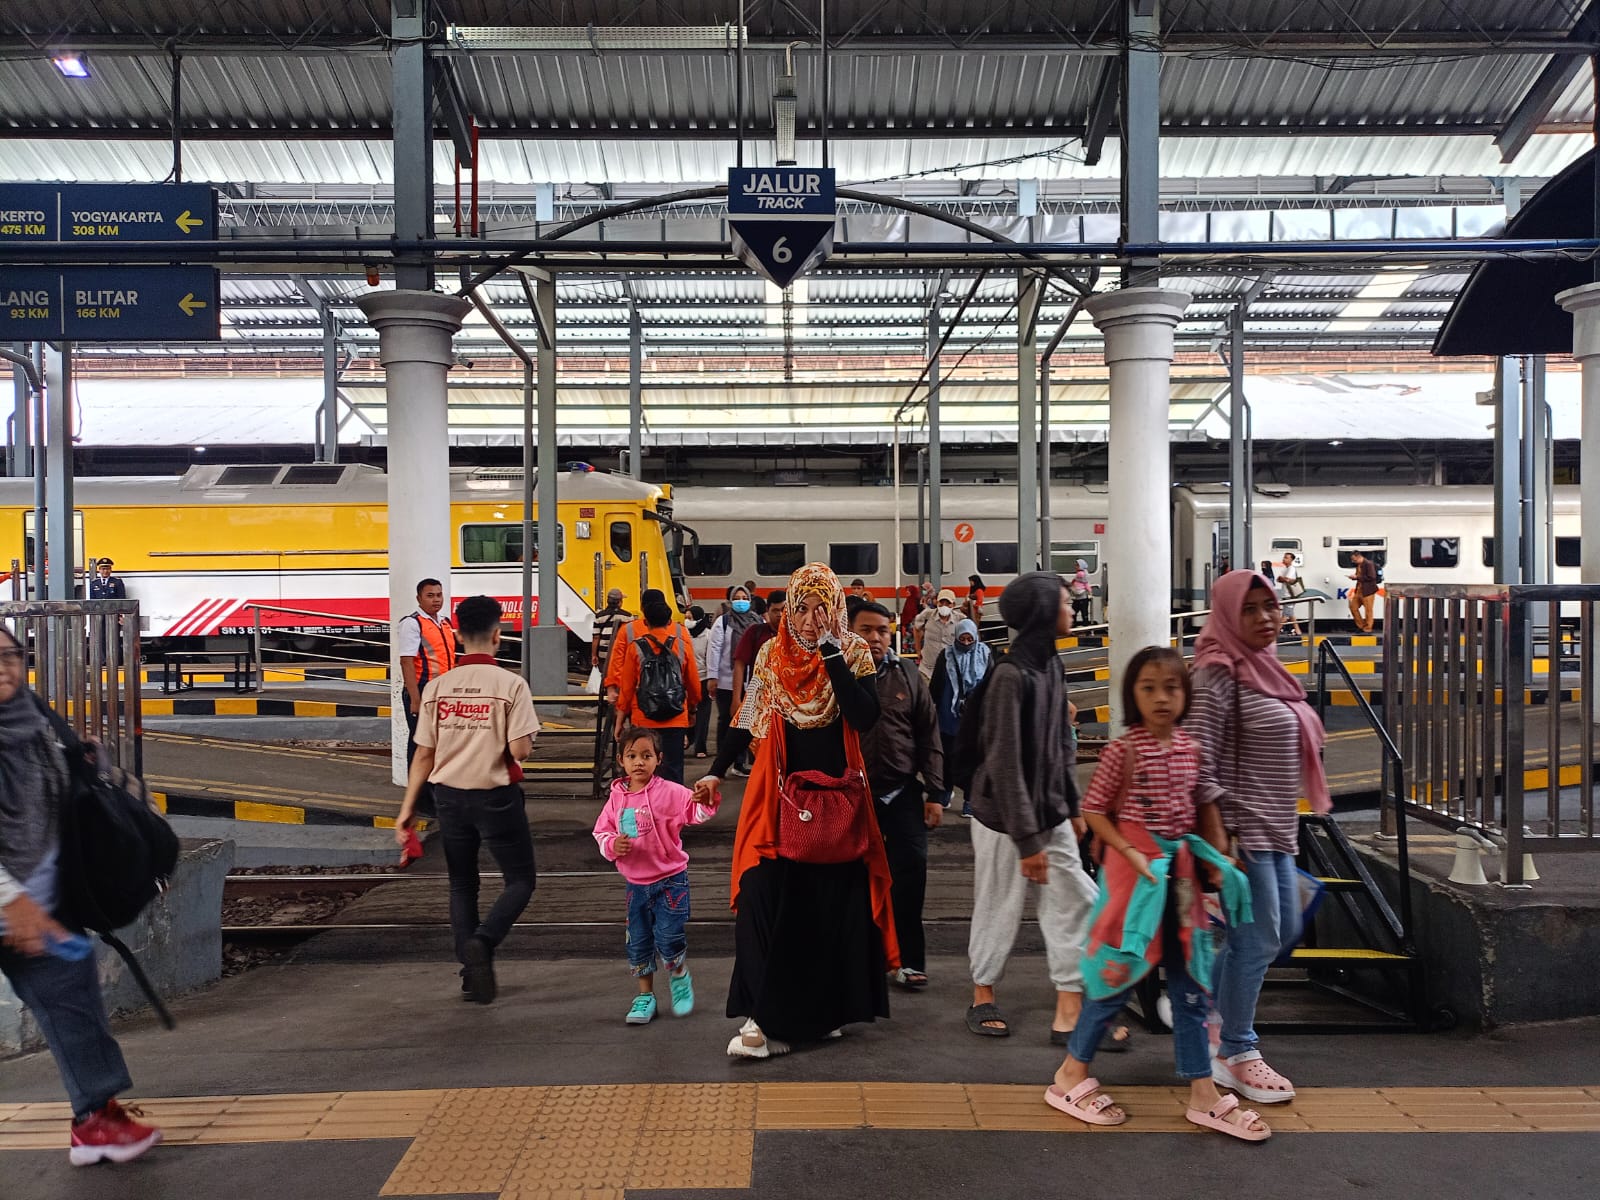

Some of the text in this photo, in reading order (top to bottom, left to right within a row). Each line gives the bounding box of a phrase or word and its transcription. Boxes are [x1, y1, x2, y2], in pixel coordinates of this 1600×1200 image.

[743, 174, 820, 193] JALUR
[757, 197, 806, 209] TRACK
[0, 211, 45, 222] KERTO
[71, 211, 164, 223] YOGYAKARTA
[1, 224, 46, 235] 475 KM
[72, 225, 119, 235] 308 KM
[772, 236, 793, 264] 6
[76, 290, 138, 305] BLITAR
[28, 308, 49, 319] KM
[99, 307, 120, 318] KM
[221, 626, 236, 635] SN
[438, 701, 490, 720] Salman
